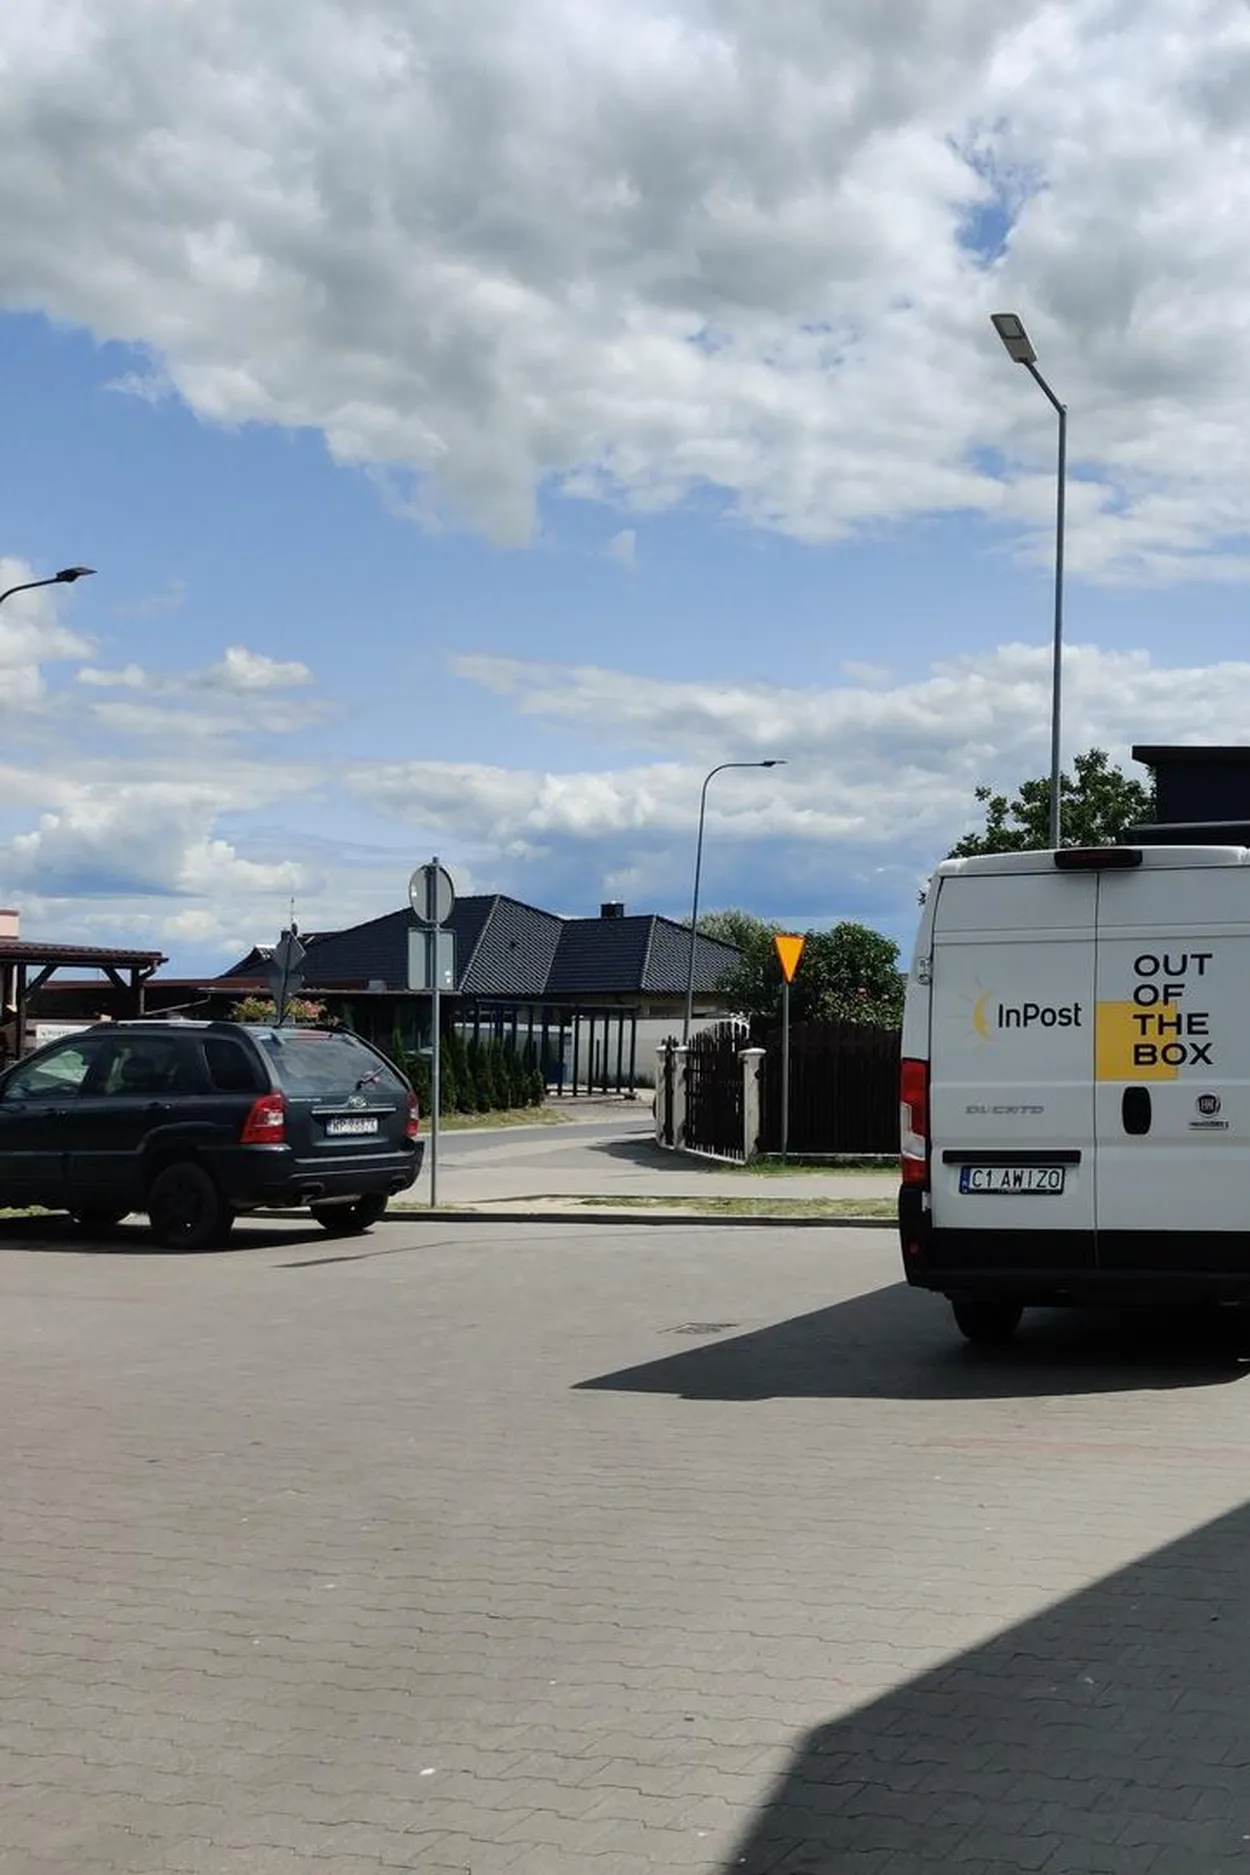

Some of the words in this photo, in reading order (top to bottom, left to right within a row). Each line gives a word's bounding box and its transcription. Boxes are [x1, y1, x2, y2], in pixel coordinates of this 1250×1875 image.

[1134, 954, 1212, 976] OUT
[1133, 983, 1185, 1006] OF
[998, 1002, 1082, 1028] InPost
[1132, 1013, 1209, 1035] THE
[1133, 1043, 1213, 1065] BOX
[972, 1170, 992, 1187] C1
